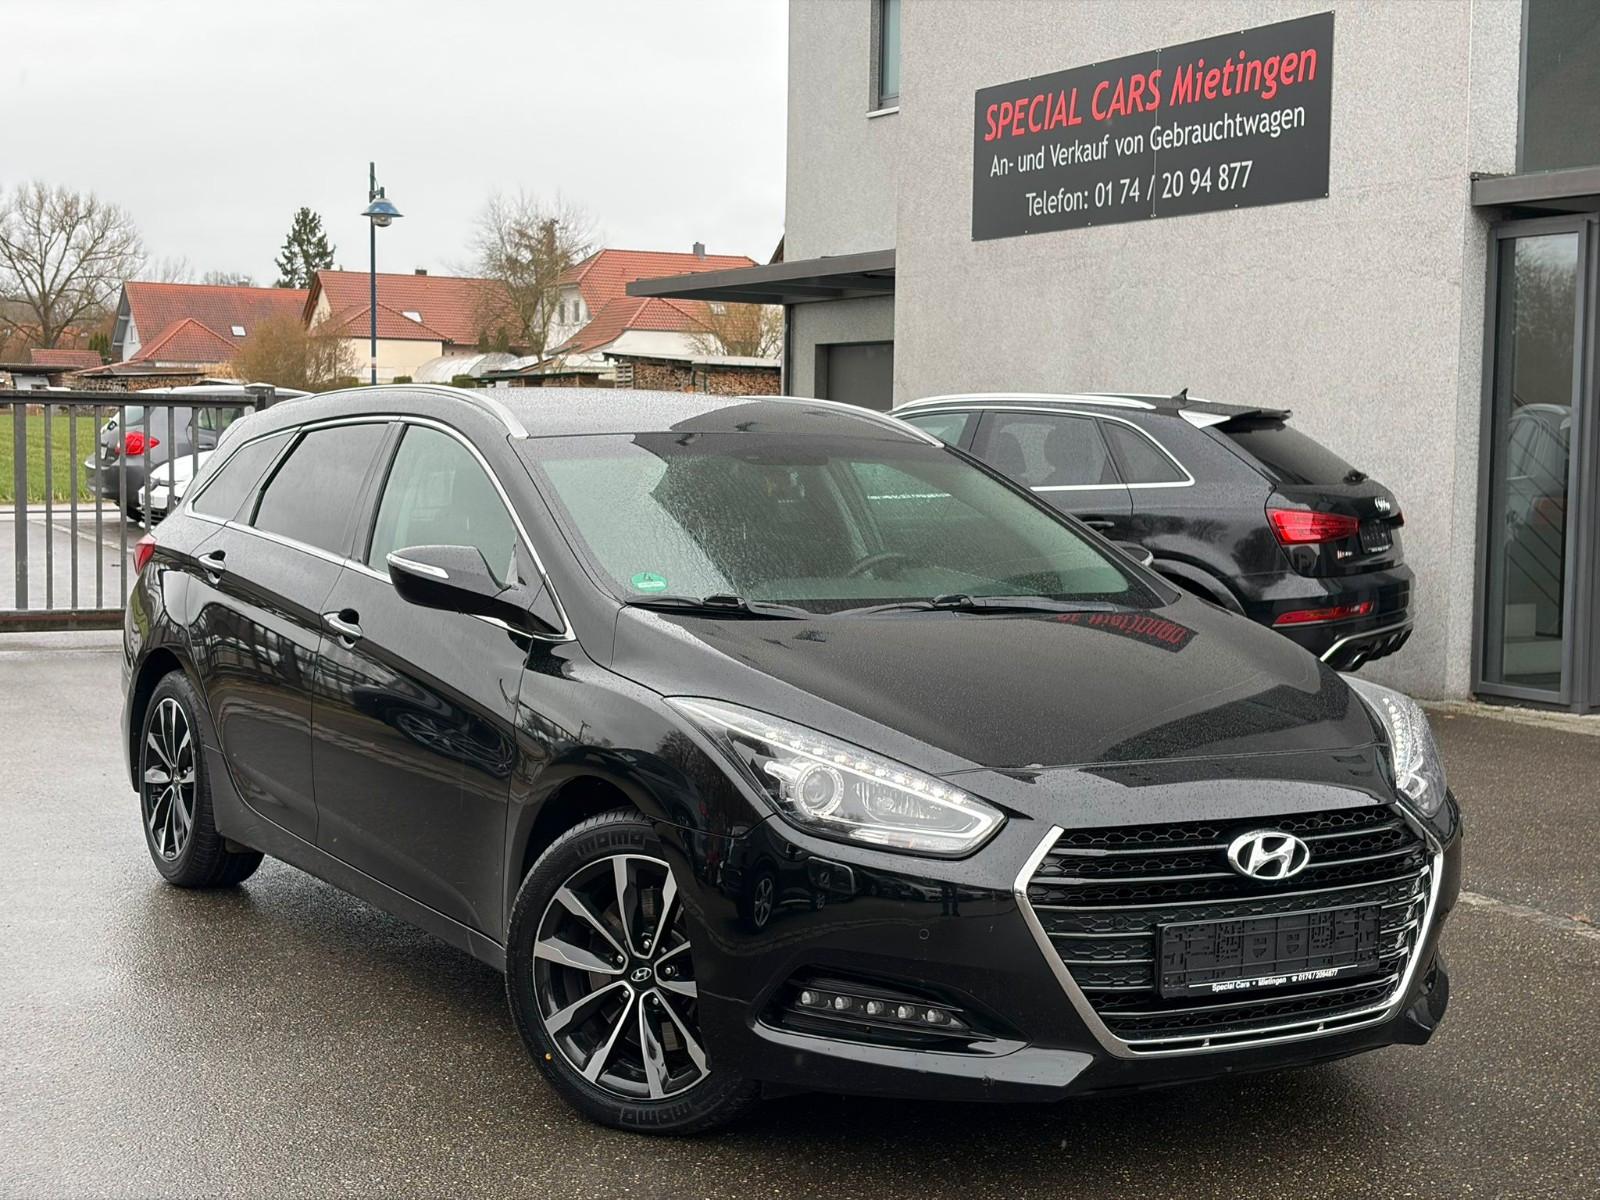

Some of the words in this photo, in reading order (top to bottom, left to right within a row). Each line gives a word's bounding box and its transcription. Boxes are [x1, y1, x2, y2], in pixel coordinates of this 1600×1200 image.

[984, 87, 1083, 142] SPECIAL
[1091, 69, 1163, 122] CARS
[1169, 48, 1318, 101] Mietingen
[990, 154, 1014, 178] An-
[1017, 144, 1045, 173] und
[1050, 133, 1110, 168] Verkauf
[1114, 134, 1144, 157] von
[1149, 106, 1305, 152] Gebrauchtwagen
[1025, 187, 1089, 217] Telefon:
[1094, 180, 1113, 208] 01
[1119, 176, 1140, 205] 74
[1146, 174, 1156, 201] /
[1161, 170, 1184, 199] 20
[1189, 166, 1212, 195] 94
[1218, 160, 1253, 191] 877
[1212, 981, 1235, 993] Special
[1236, 980, 1250, 989] Cars
